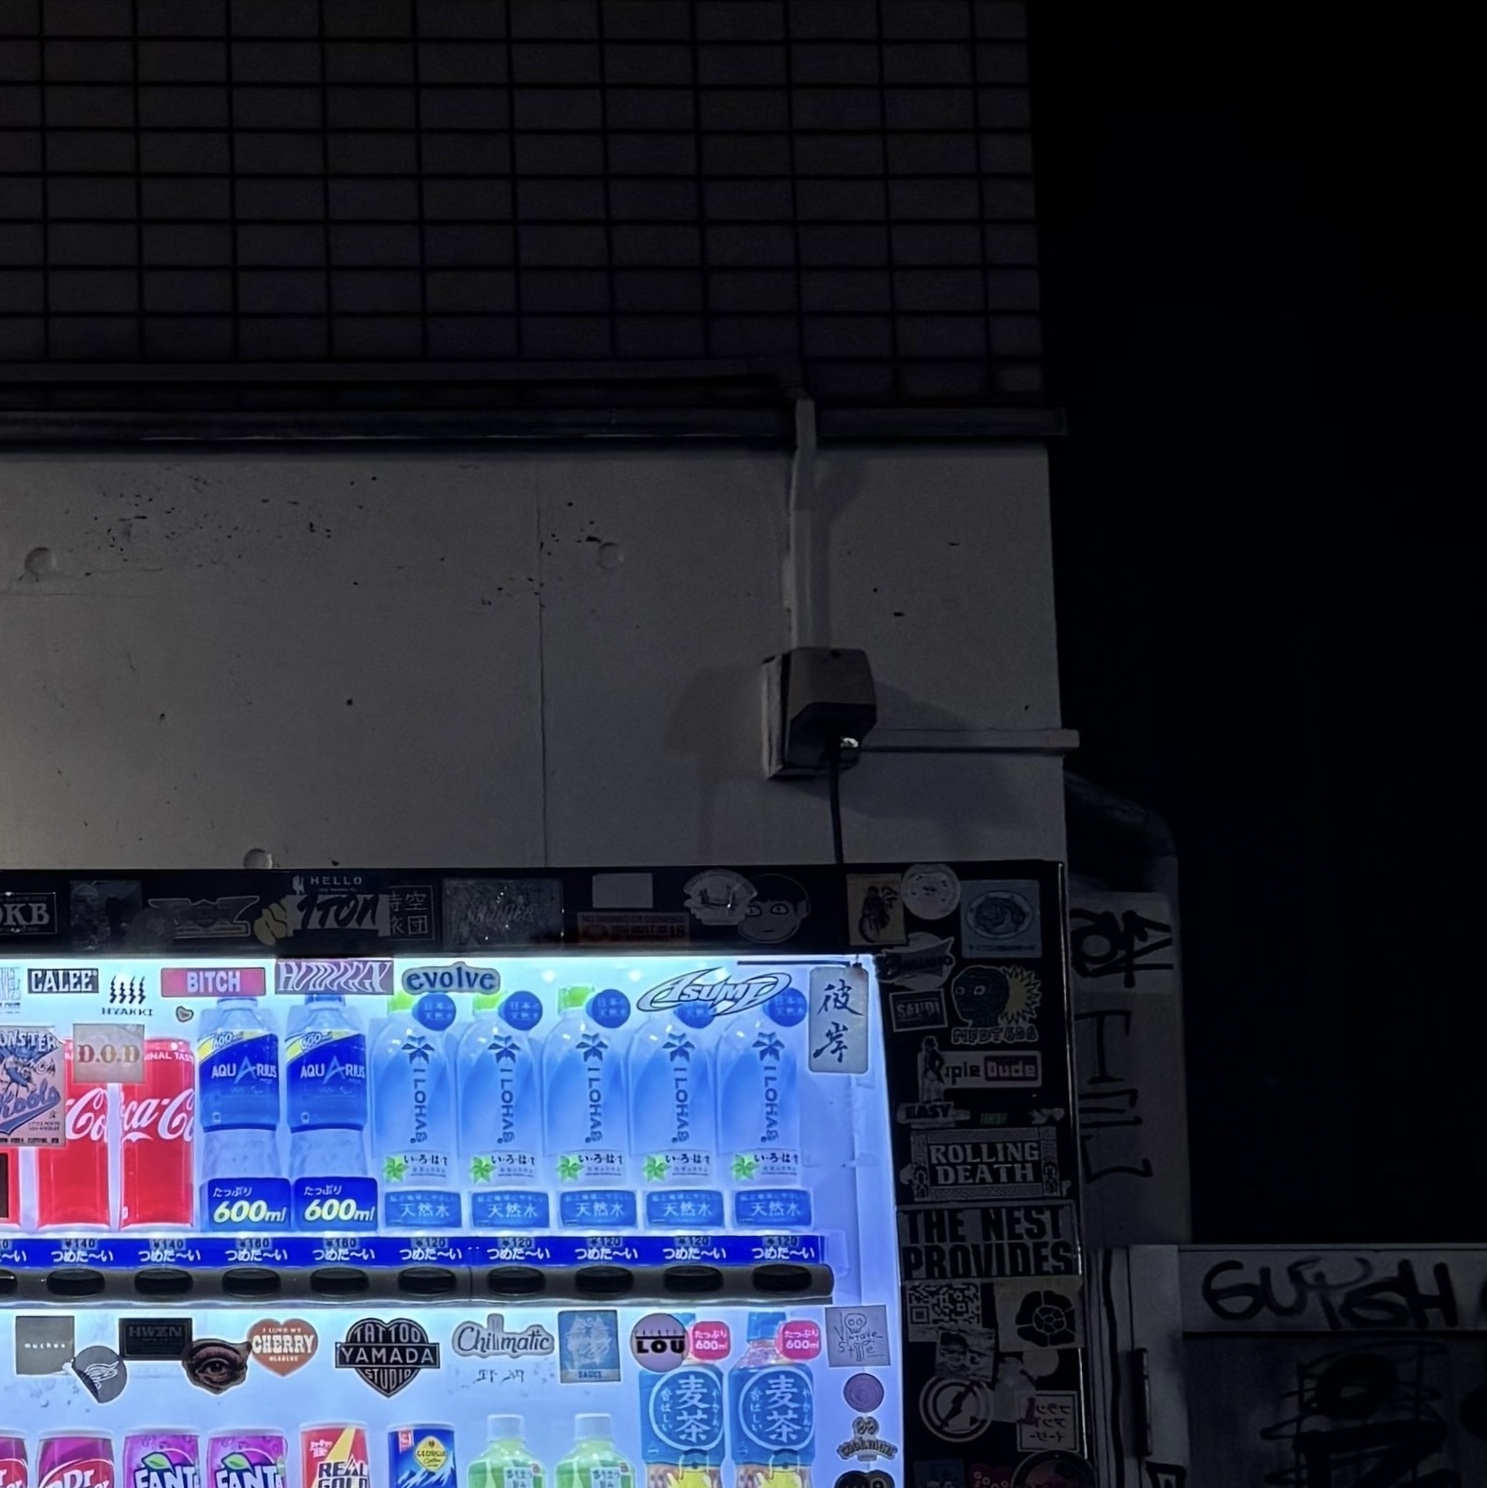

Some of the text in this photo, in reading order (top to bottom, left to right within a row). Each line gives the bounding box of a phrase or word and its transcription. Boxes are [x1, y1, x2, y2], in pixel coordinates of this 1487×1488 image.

[310, 876, 363, 886] HELLO
[187, 971, 240, 992] BITCH
[406, 966, 495, 990] evolve
[212, 1056, 277, 1083] AQUARIUS
[301, 1056, 365, 1083] AQUARIUS
[987, 1060, 1038, 1078] Dude
[930, 1143, 1040, 1164] ROLLING
[938, 1164, 1035, 1184] DEATH
[213, 1186, 252, 1197] たっぷり
[304, 1185, 342, 1196] たっぷり
[213, 1201, 287, 1223] 600ml
[304, 1199, 375, 1222] 600ml
[400, 1203, 450, 1218] 天然水
[487, 1203, 538, 1218] 天然水
[576, 1202, 625, 1217] 天然水
[663, 1202, 712, 1217] 天然水
[907, 1206, 1060, 1242] THE NEST
[905, 1241, 1074, 1280] PROVIDES
[354, 1320, 421, 1342] TATTOO
[252, 1335, 315, 1354] CHERRY
[341, 1346, 436, 1364] YAMADA
[363, 1367, 413, 1390] STUDIO
[676, 1375, 708, 1442] 麦茶
[765, 1374, 802, 1443] 麦茶
